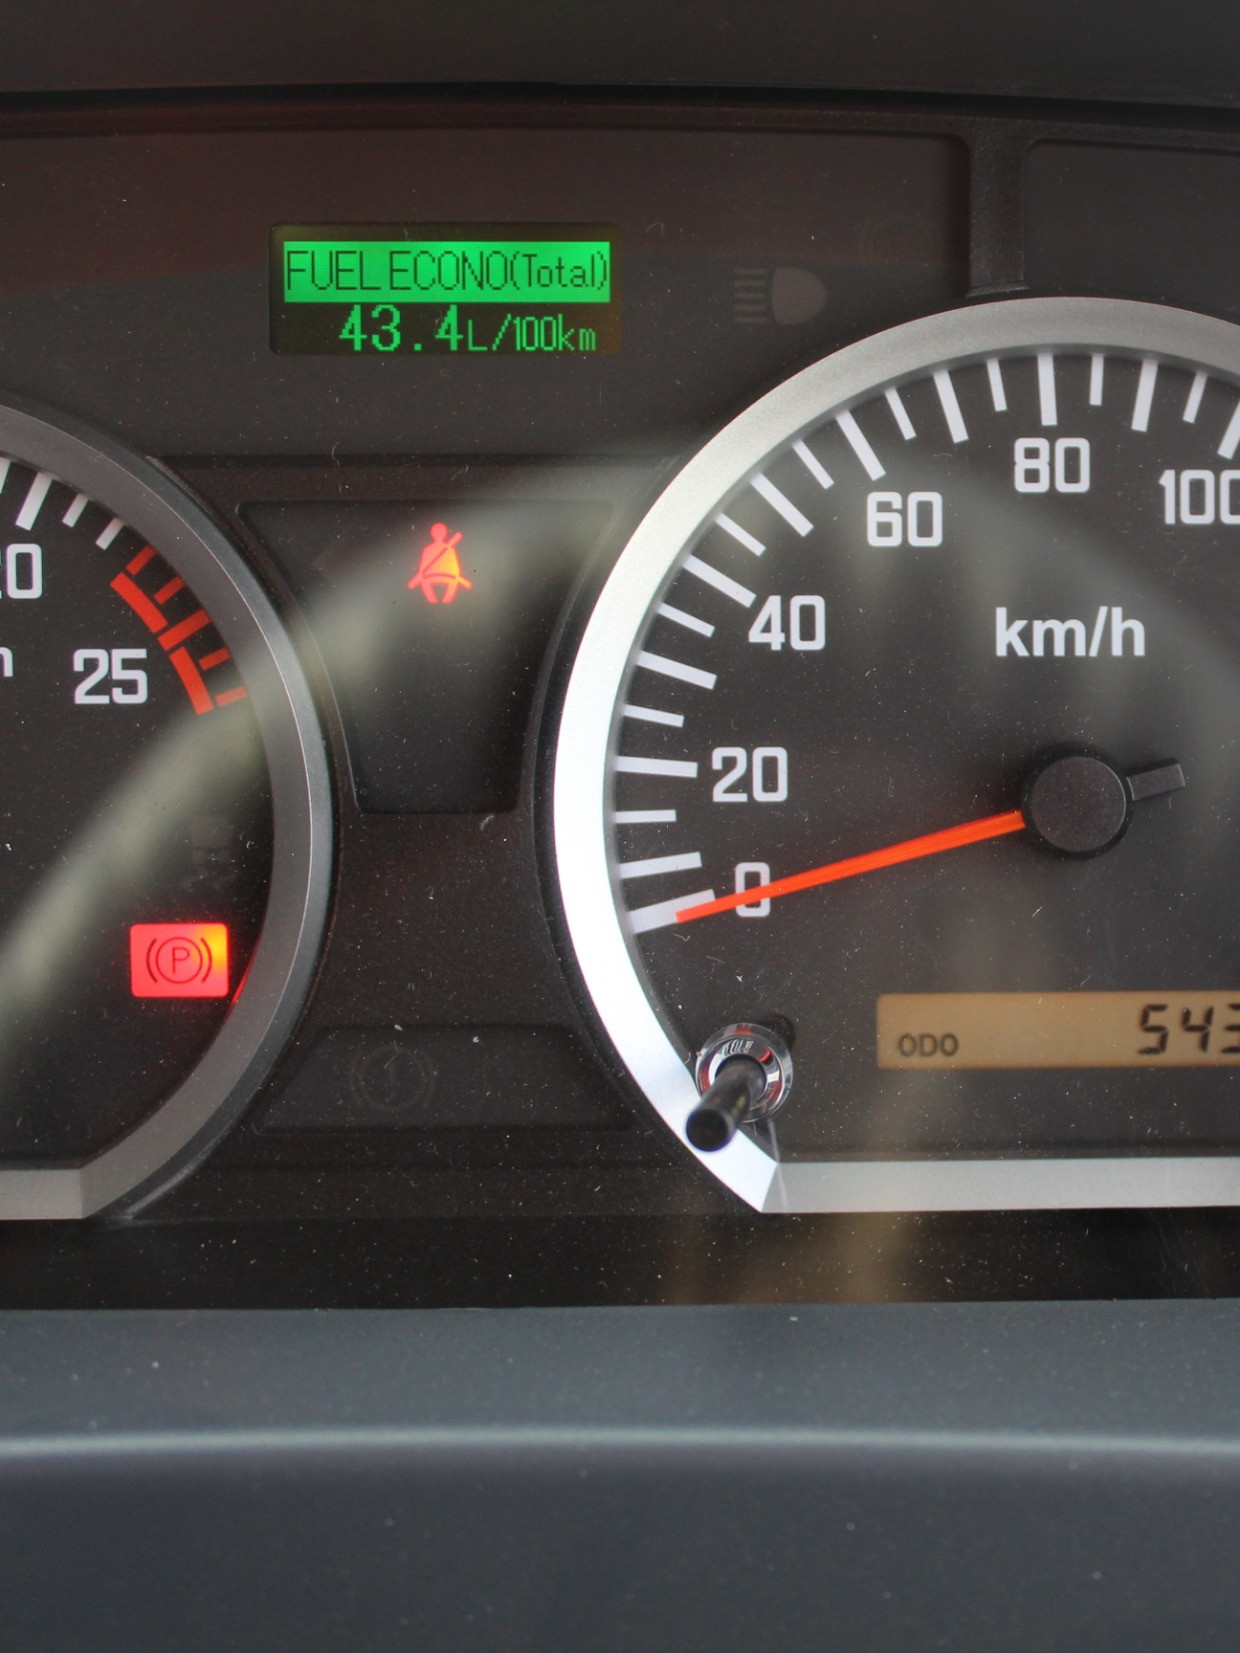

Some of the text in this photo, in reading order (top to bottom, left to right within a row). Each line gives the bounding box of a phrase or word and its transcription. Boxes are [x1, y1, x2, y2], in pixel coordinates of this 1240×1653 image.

[286, 250, 382, 291] FUEL
[1014, 437, 1090, 493] 80
[866, 491, 943, 547] 60
[0, 543, 43, 599] 0
[747, 595, 827, 651] 40
[995, 605, 1146, 659] km/h
[73, 648, 148, 704] 25
[711, 746, 788, 803] 20
[735, 862, 771, 918] 0
[898, 1033, 959, 1058] ODO
